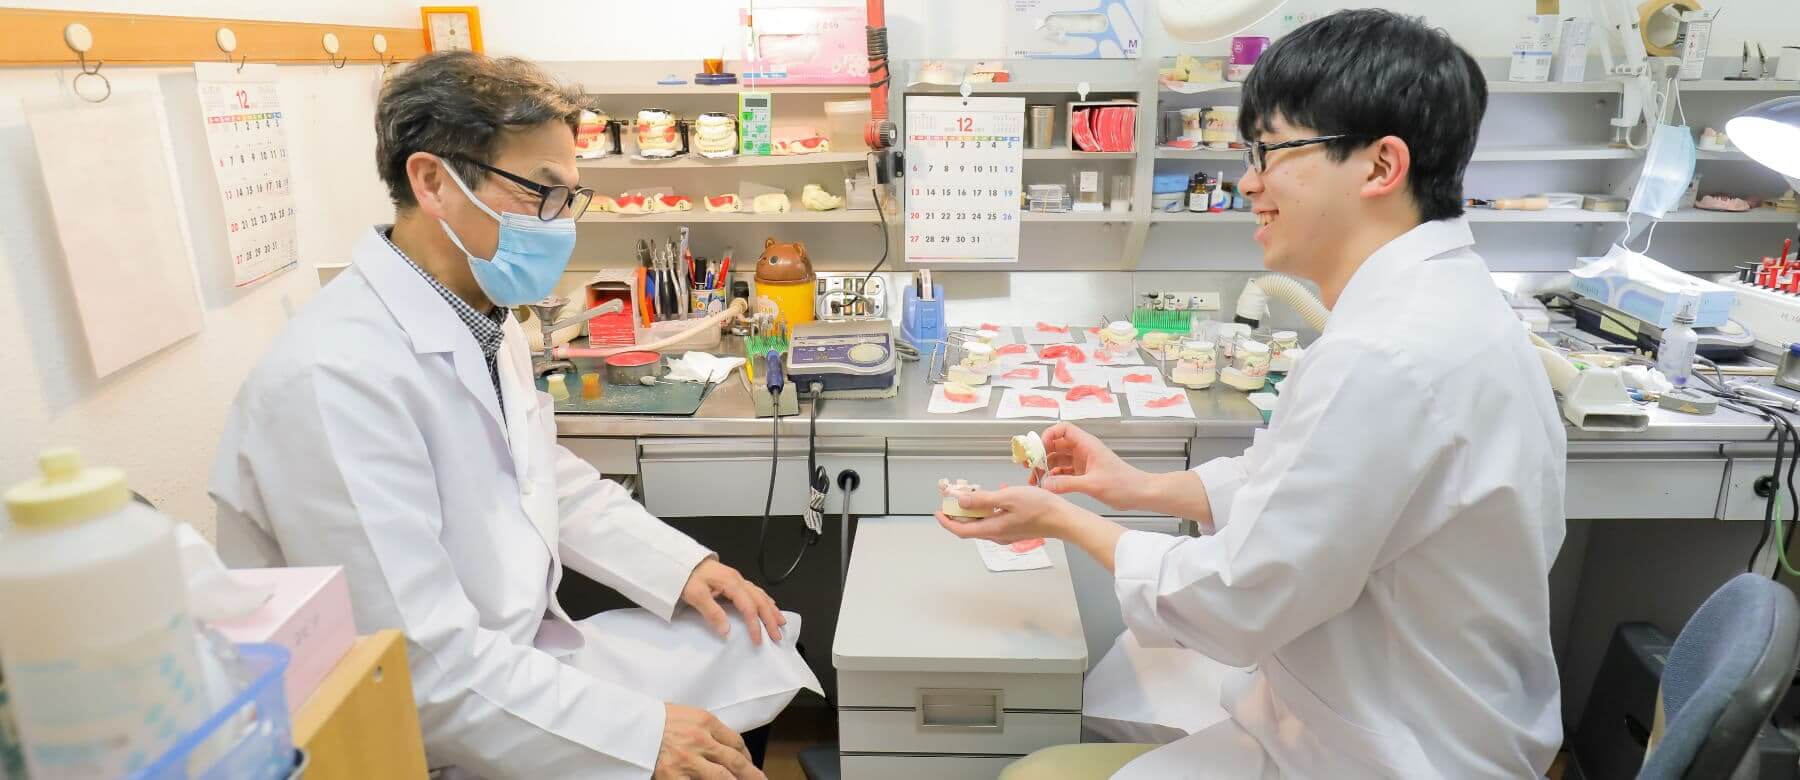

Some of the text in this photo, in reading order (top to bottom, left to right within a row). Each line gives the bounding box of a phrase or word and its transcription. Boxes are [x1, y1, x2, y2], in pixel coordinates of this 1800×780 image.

[1128, 40, 1137, 48] M
[236, 90, 250, 109] 12
[957, 117, 974, 132] 12
